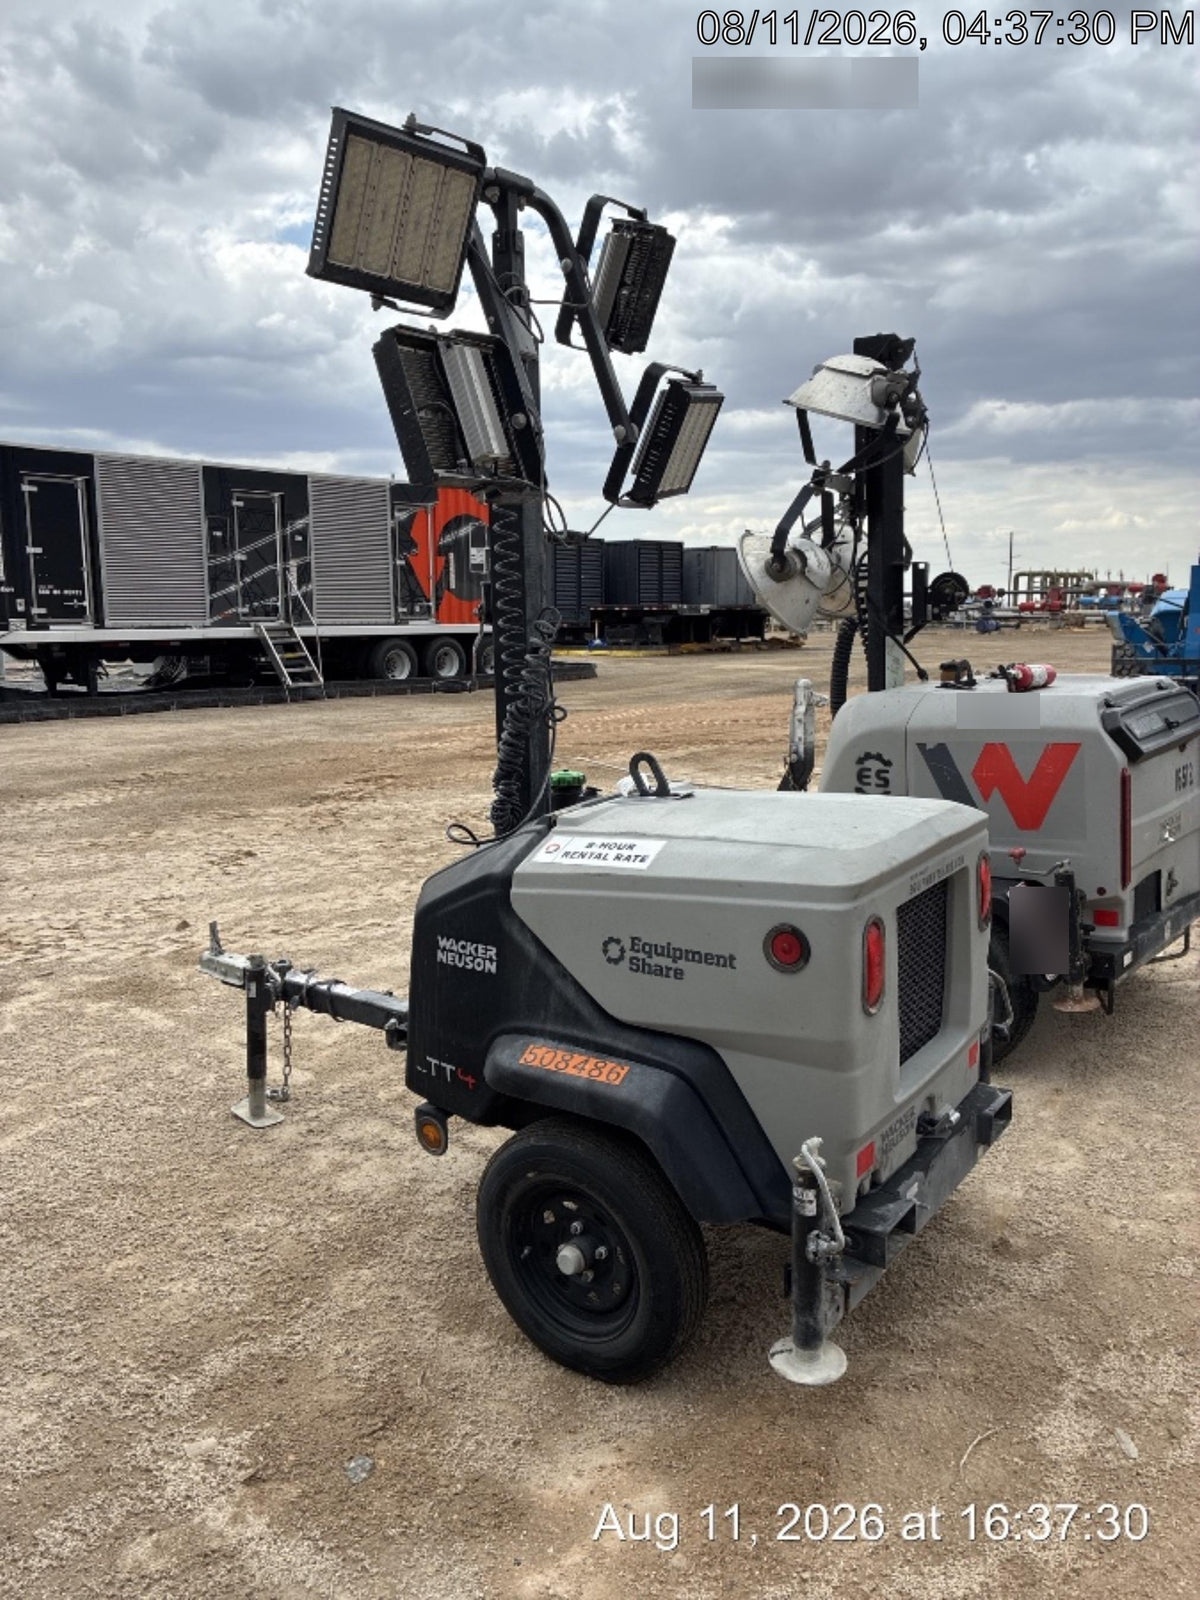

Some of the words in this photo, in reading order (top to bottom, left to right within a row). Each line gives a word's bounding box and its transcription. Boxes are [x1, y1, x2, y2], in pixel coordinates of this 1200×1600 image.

[561, 851, 610, 861] RENTAL
[613, 854, 649, 863] RATE
[437, 935, 497, 960] WACKER
[629, 936, 737, 969] Equipment
[436, 949, 497, 974] NEUSON
[629, 956, 685, 980] Share
